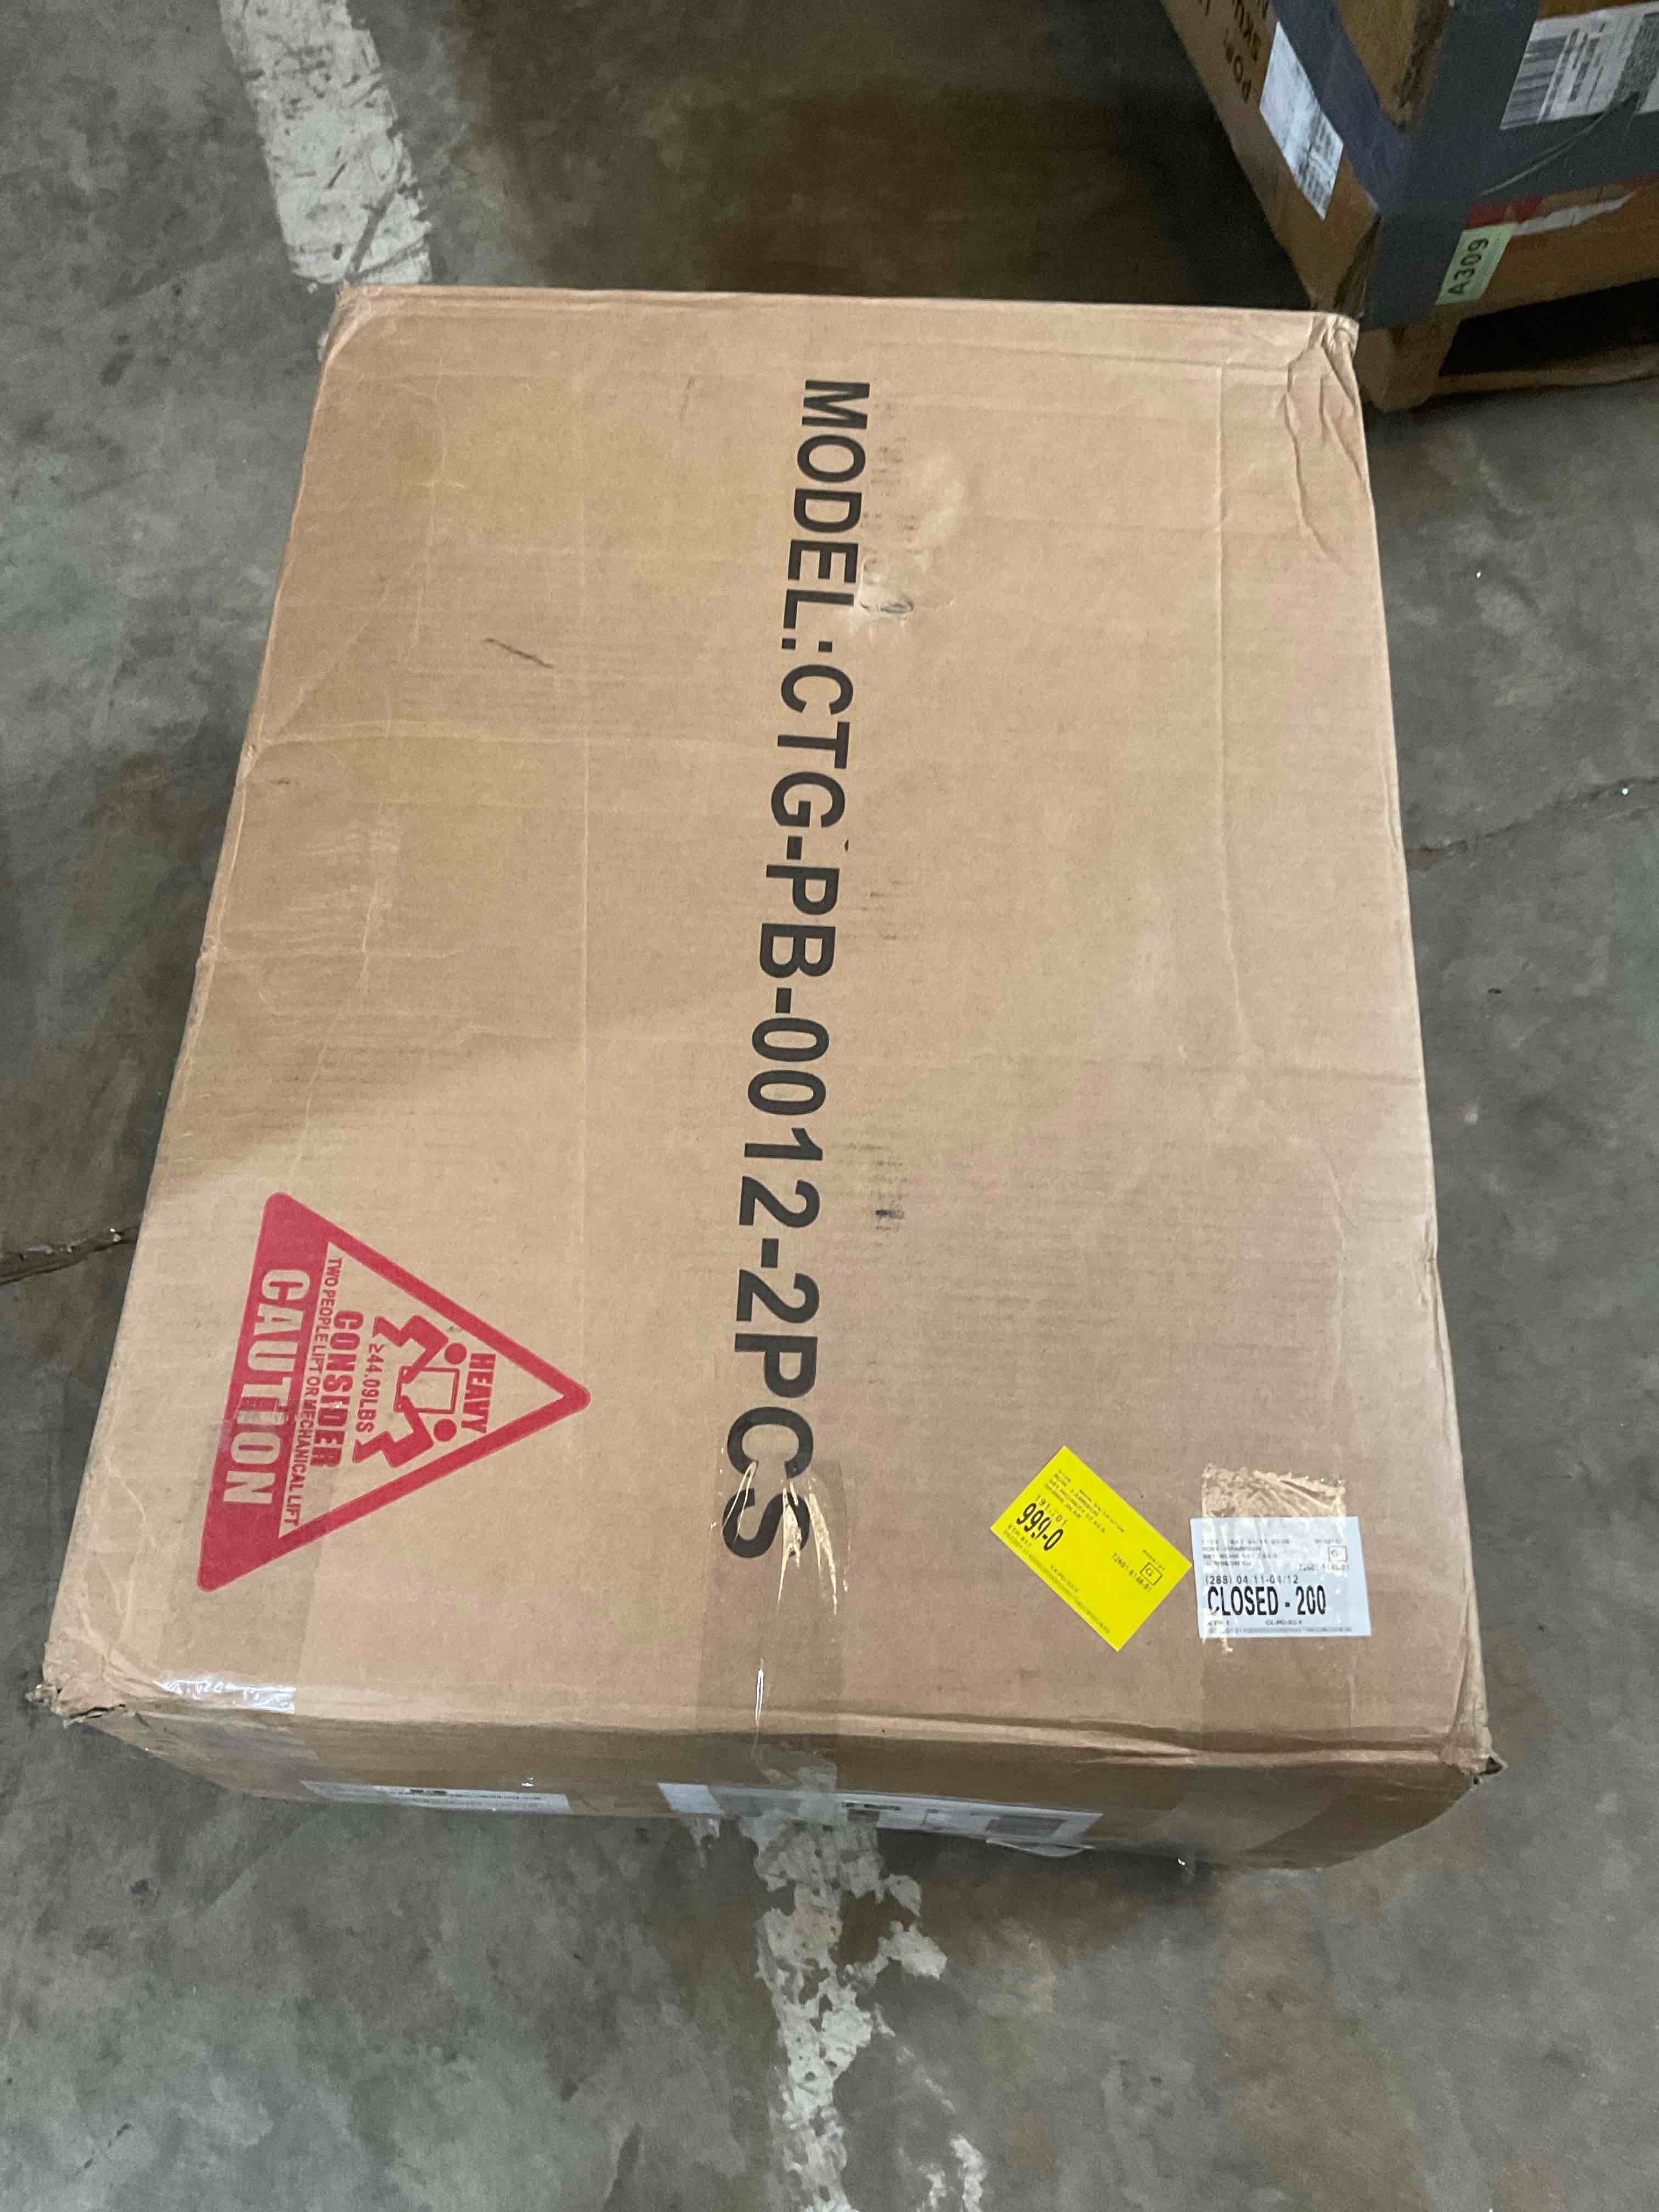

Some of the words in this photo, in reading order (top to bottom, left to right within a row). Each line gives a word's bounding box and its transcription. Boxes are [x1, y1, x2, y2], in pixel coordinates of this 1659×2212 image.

[1447, 238, 1489, 295] A309
[324, 1257, 343, 1287] TWO
[314, 1289, 336, 1342] PEOPLE
[304, 1376, 321, 1397] OR
[309, 1345, 327, 1375] LIFT
[222, 1269, 311, 1505] CAUTION
[311, 1310, 364, 1469] CONSIDER
[461, 1352, 496, 1434] HEAVY
[289, 1398, 317, 1493] MECHANICAL
[284, 1494, 303, 1527] LIFT
[1207, 1585, 1279, 1616] CLOSED
[1295, 1585, 1326, 1616] 200
